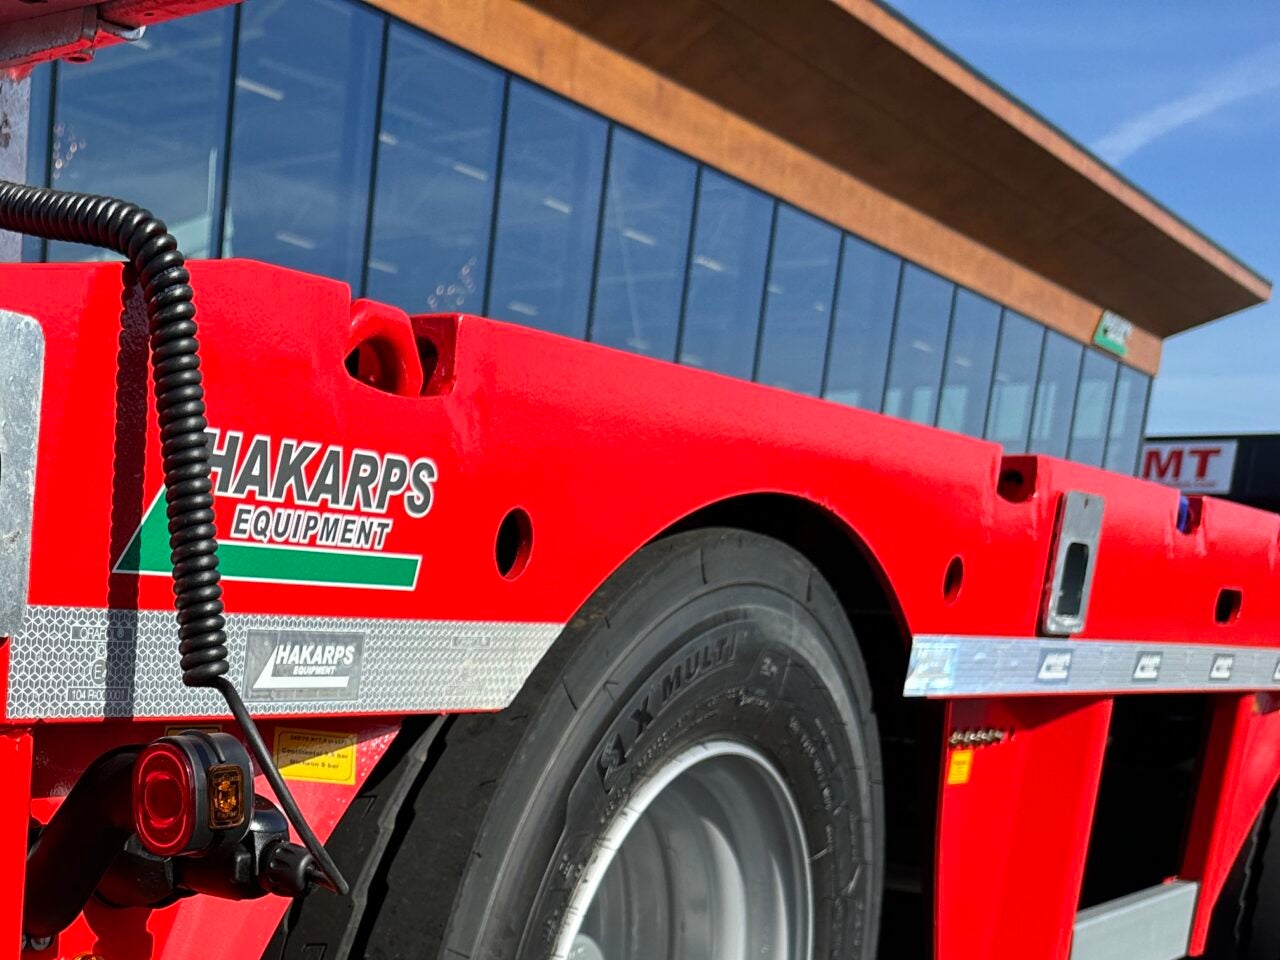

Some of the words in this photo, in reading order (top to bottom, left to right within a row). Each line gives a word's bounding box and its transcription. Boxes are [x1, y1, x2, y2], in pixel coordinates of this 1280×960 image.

[203, 427, 438, 519] HAKARPS
[1142, 447, 1221, 480] MT
[230, 504, 393, 549] EQUIPMENT
[276, 644, 355, 665] HAKARPS
[293, 665, 337, 675] EQUIPMENT
